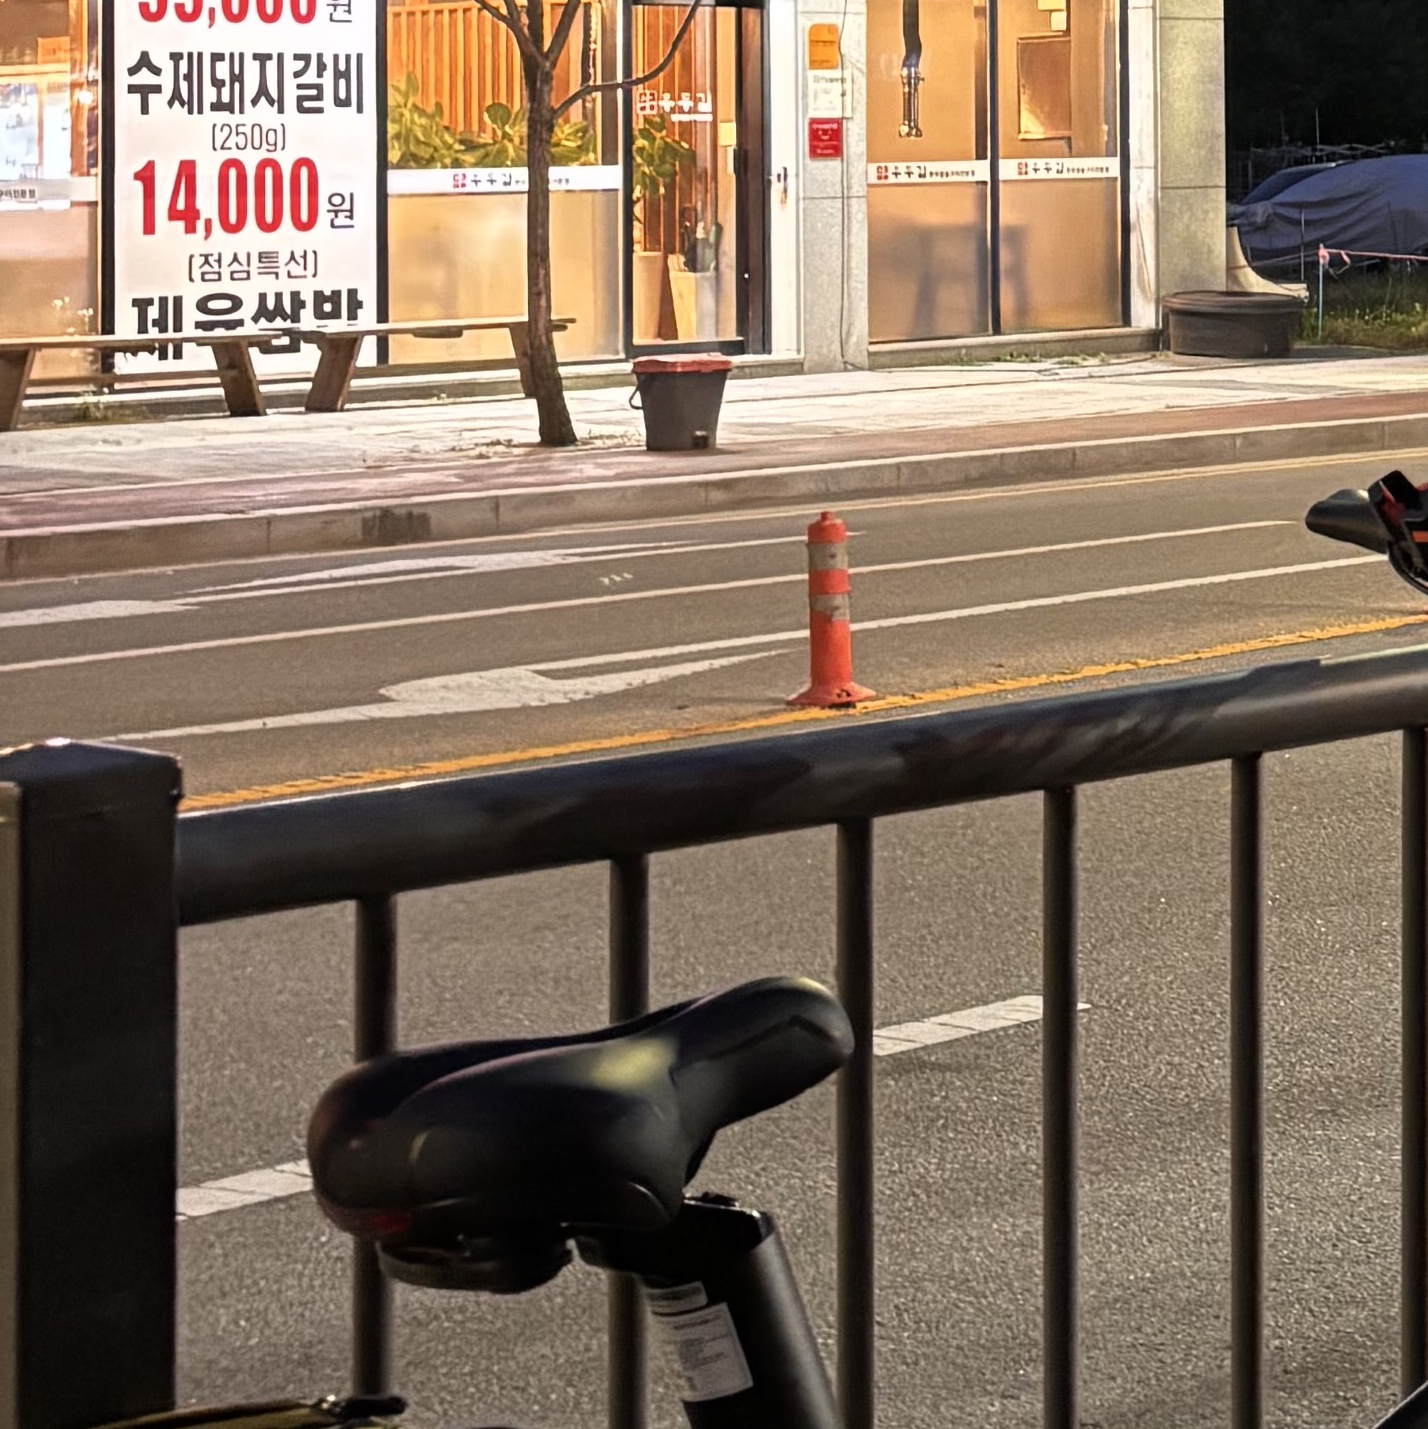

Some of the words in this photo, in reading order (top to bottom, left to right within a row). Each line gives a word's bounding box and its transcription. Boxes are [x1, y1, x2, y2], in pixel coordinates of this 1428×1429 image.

[127, 50, 364, 115] 수제돼지갈비
[212, 123, 286, 152] (250g)
[188, 249, 318, 283] (점심특선)
